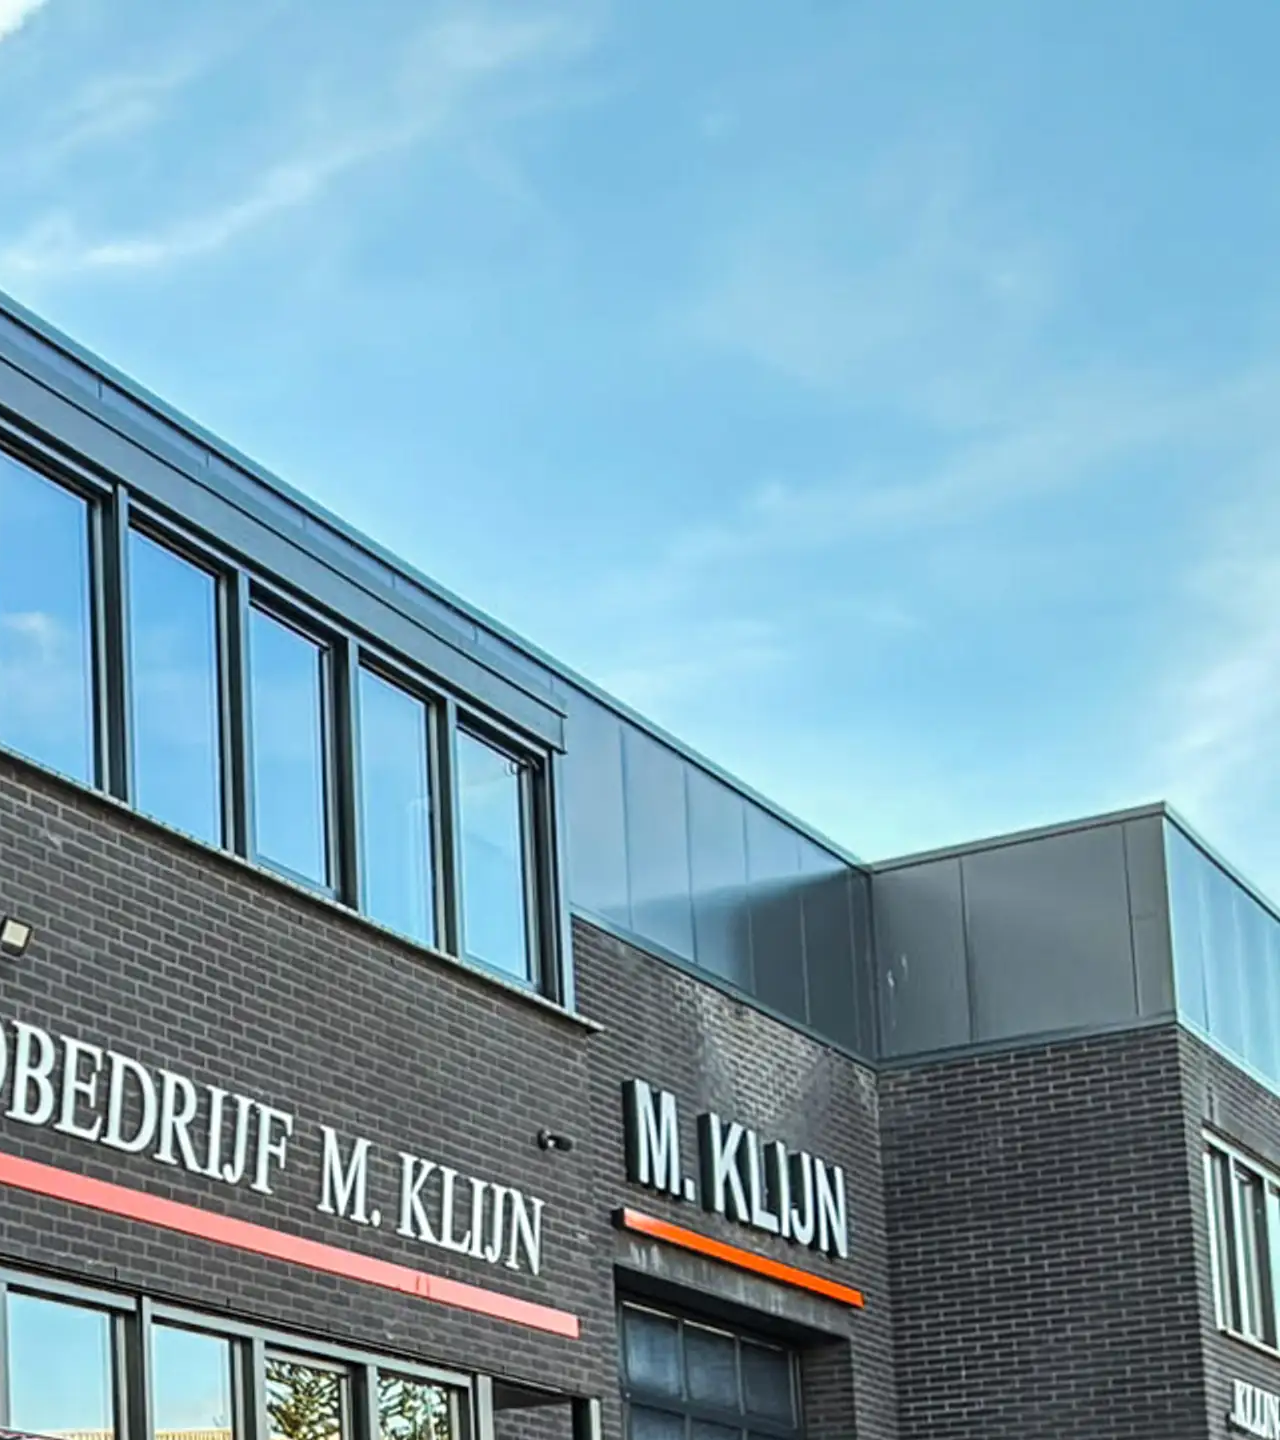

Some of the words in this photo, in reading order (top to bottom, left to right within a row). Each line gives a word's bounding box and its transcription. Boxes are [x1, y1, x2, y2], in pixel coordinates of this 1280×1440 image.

[317, 1123, 382, 1227] M.
[396, 1151, 546, 1276] KLIJN
[634, 1078, 696, 1202] M.
[709, 1111, 849, 1259] KLIJN
